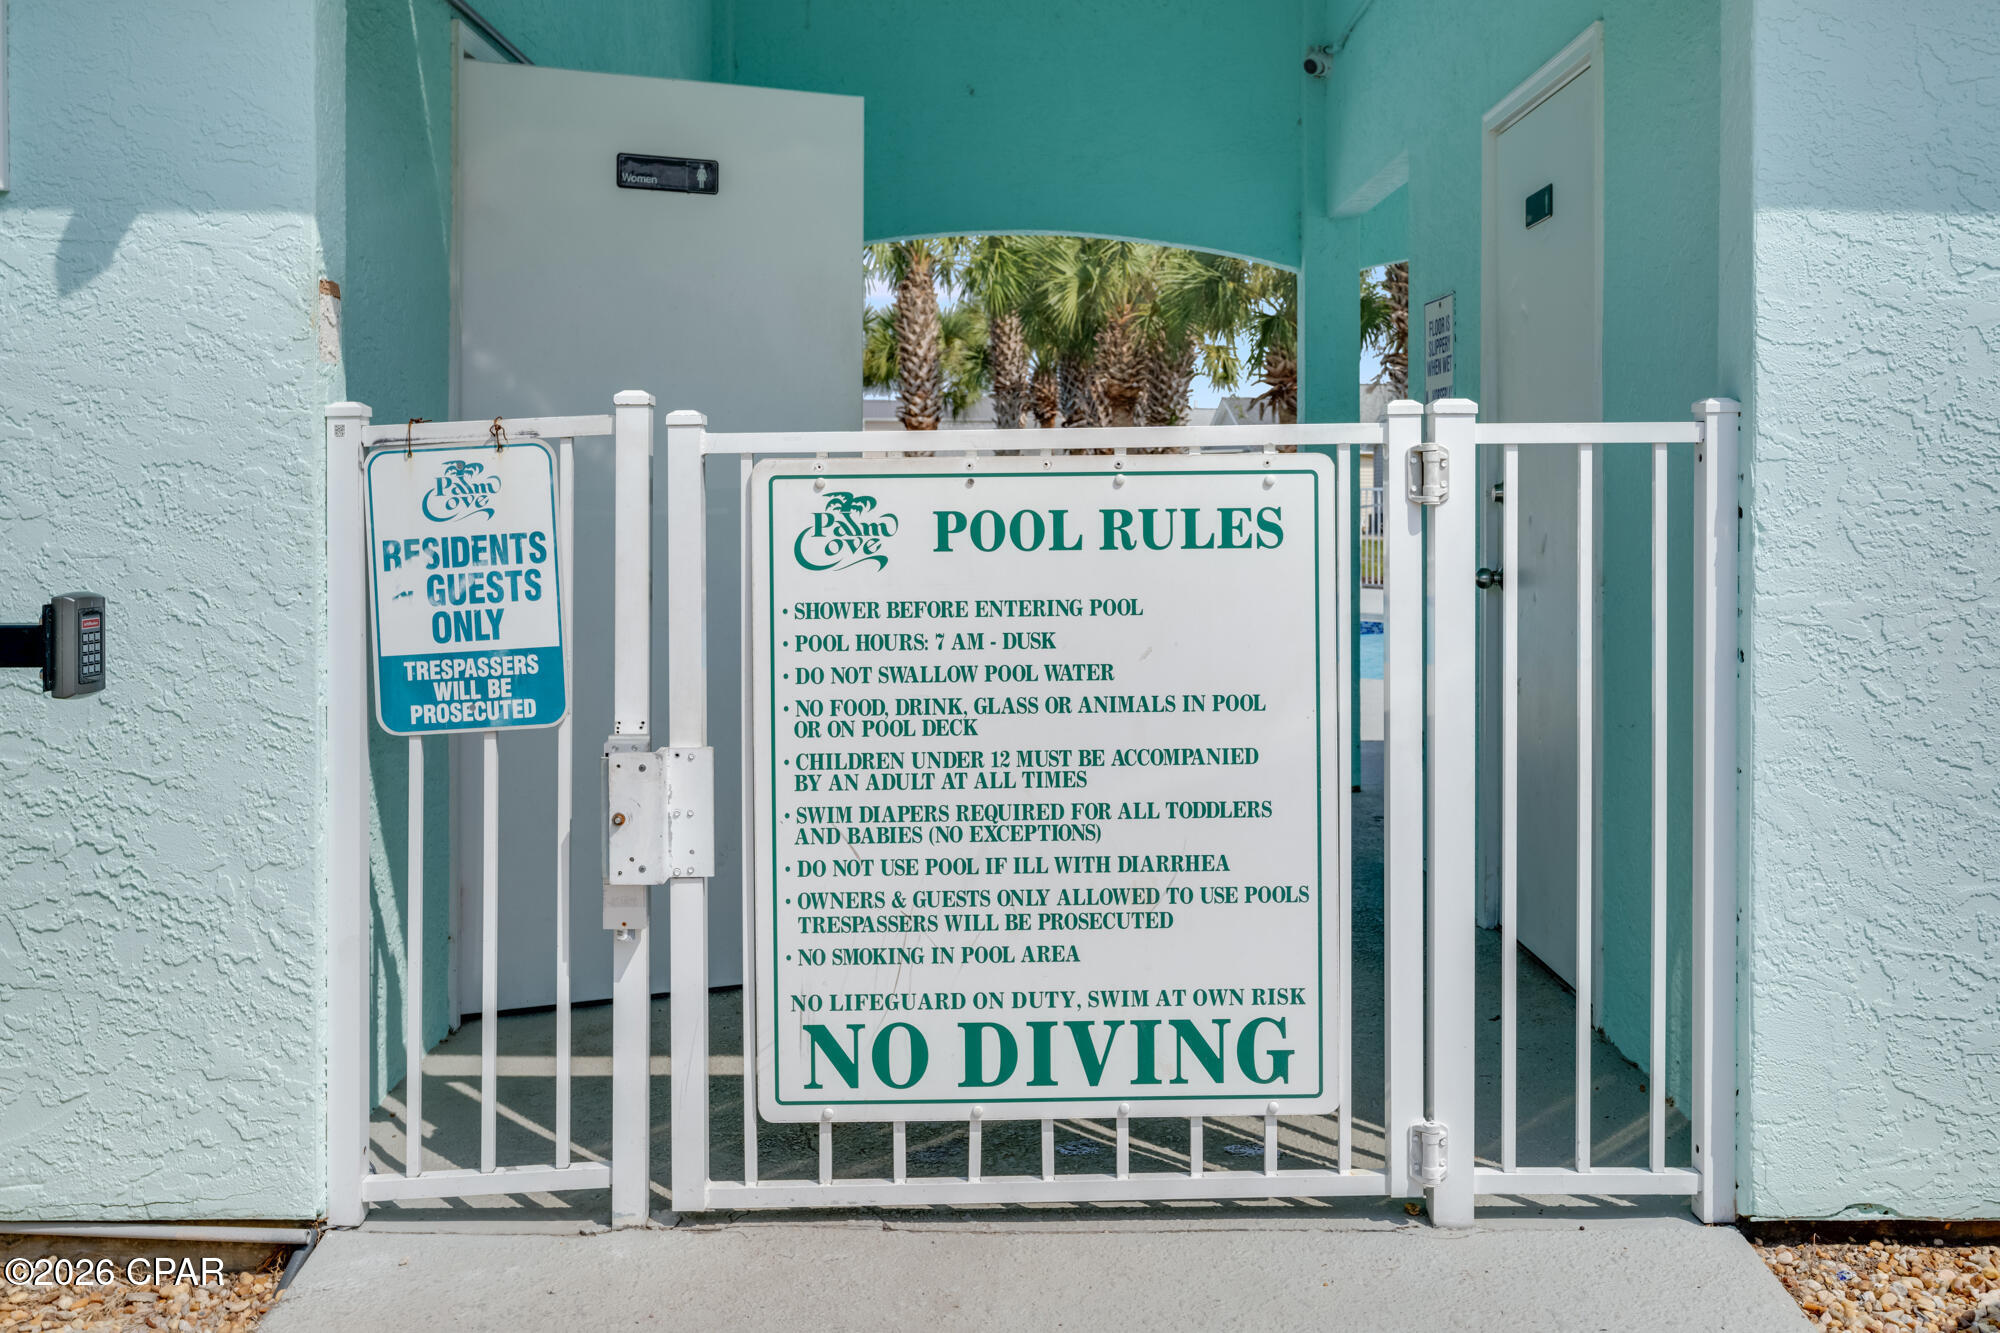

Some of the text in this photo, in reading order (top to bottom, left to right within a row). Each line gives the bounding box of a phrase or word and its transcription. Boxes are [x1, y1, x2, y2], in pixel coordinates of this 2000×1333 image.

[622, 172, 658, 184] Women
[1429, 317, 1445, 337] FLOOR
[1429, 335, 1451, 357] SLIPPERY
[1427, 354, 1452, 377] WHEN WET
[434, 475, 501, 496] Palm
[811, 512, 898, 537] Palm
[933, 507, 1285, 552] POOL RULES
[382, 531, 547, 572] RESIDENTS
[427, 568, 542, 607] GUESTS
[794, 598, 1144, 620] SHOWER BEFORE ENTERING POOL
[432, 608, 504, 644] ONLY
[795, 634, 849, 652] POOL
[856, 633, 928, 652] HOURS:
[935, 633, 945, 651] 7
[952, 632, 984, 650] AM
[1003, 632, 1057, 650] DUSK
[403, 654, 539, 681] TRESPASSERS
[796, 664, 1115, 685] DO NOT SWALLOW POOL WATER
[433, 677, 512, 701] WILL BE
[410, 698, 537, 725] PROSECUTED
[795, 694, 1266, 721] NO FOOD, DRINK, GLASS OR ANIMALS IN POOL
[794, 719, 978, 738] OR ON POOL DECK
[796, 747, 1259, 771] CHILDREN UNDER 12 MUST BE ACCOMPANIED
[795, 770, 1087, 792] BY AN ADULT AT ALL TIMES
[796, 800, 1272, 824] SWIM DIAPERS REQUIRED FOR ALL TODDLERS
[795, 823, 1102, 845] AND BABIES (NO EXCEPTIONS)
[798, 854, 1230, 878] DO NOT USE POOL IF ILL WITH DIARRHEA
[797, 886, 1310, 910] OWNERS & GUESTS ONLY ALLOWED TO USE POOLS
[797, 912, 1173, 934] TRESPASSERS WILL BE PROSECUTED
[799, 945, 1080, 966] NO SMOKING IN POOL AREA
[791, 987, 1306, 1012] NO LIFEGUARD ON DUTY, SWIM AT OWN RISK
[803, 1016, 1295, 1090] NO DIVING
